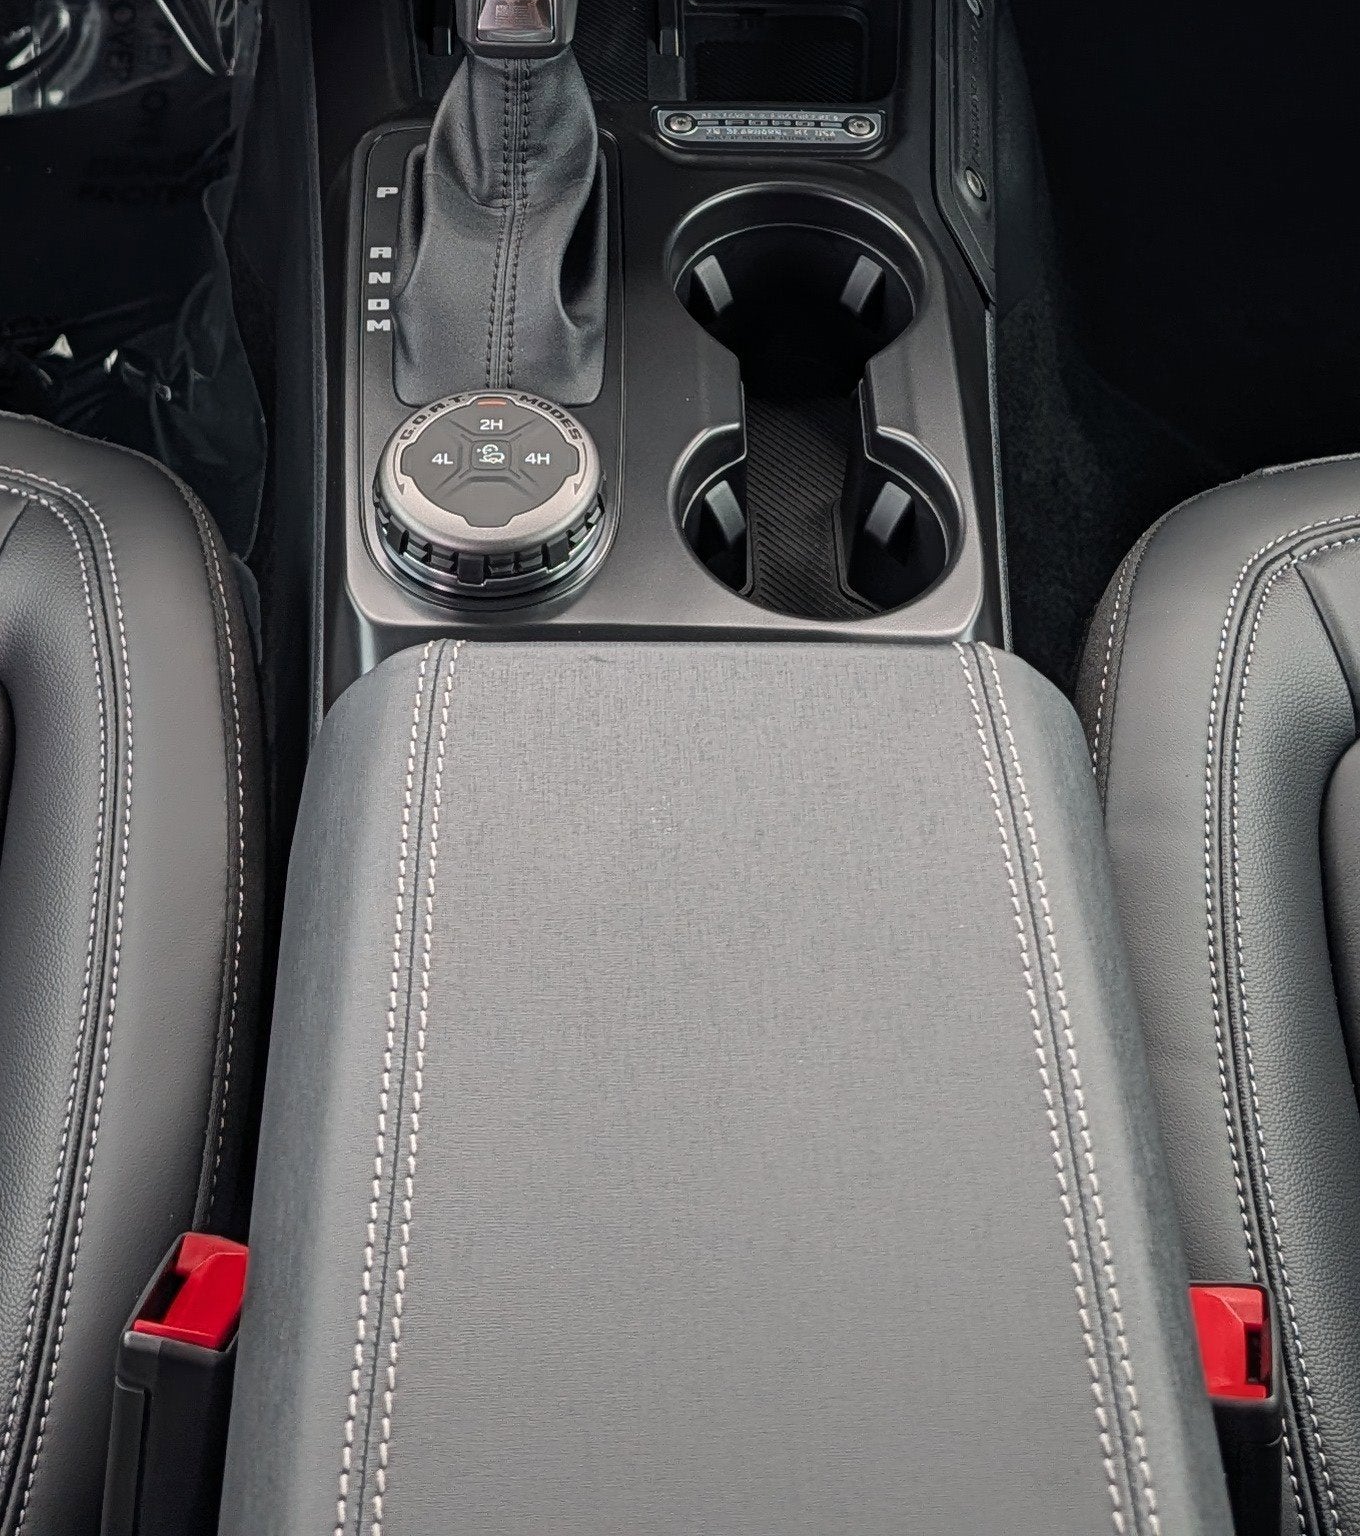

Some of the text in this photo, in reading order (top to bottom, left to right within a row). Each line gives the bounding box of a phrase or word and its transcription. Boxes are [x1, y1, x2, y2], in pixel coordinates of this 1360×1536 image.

[376, 186, 399, 198] P
[368, 272, 391, 284] N
[367, 319, 391, 331] M
[519, 394, 583, 441] MODES
[480, 419, 503, 431] 2H
[432, 453, 453, 465] 4L
[525, 453, 550, 465] 4H
